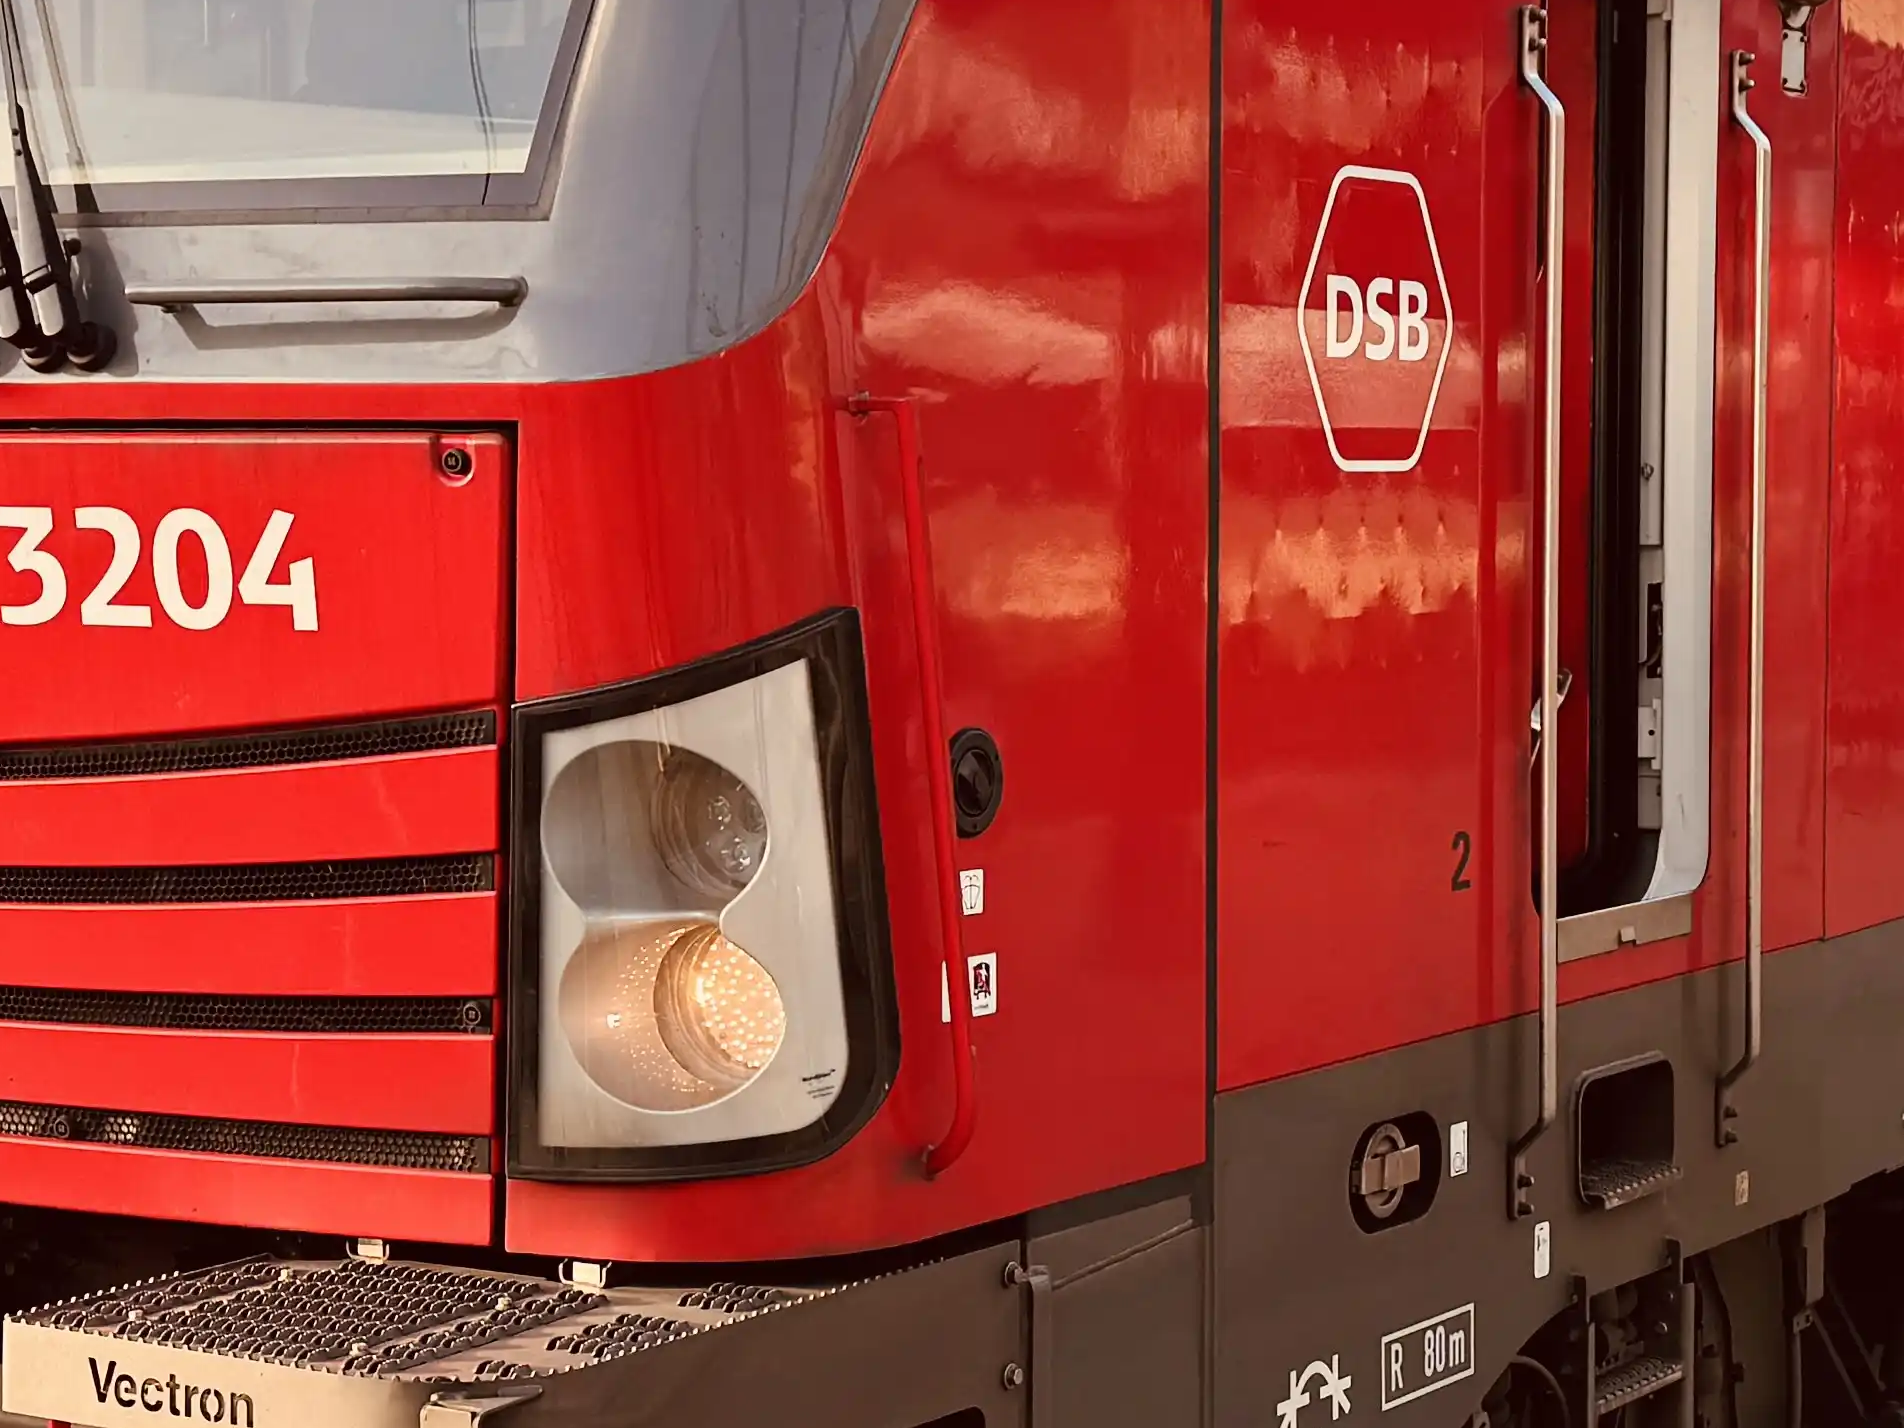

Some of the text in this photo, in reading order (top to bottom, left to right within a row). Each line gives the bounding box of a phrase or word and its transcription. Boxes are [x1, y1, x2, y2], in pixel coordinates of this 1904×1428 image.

[1326, 273, 1430, 362] DSB
[1450, 831, 1472, 892] 2
[88, 1357, 254, 1428] Vectron
[1390, 1342, 1404, 1392] R
